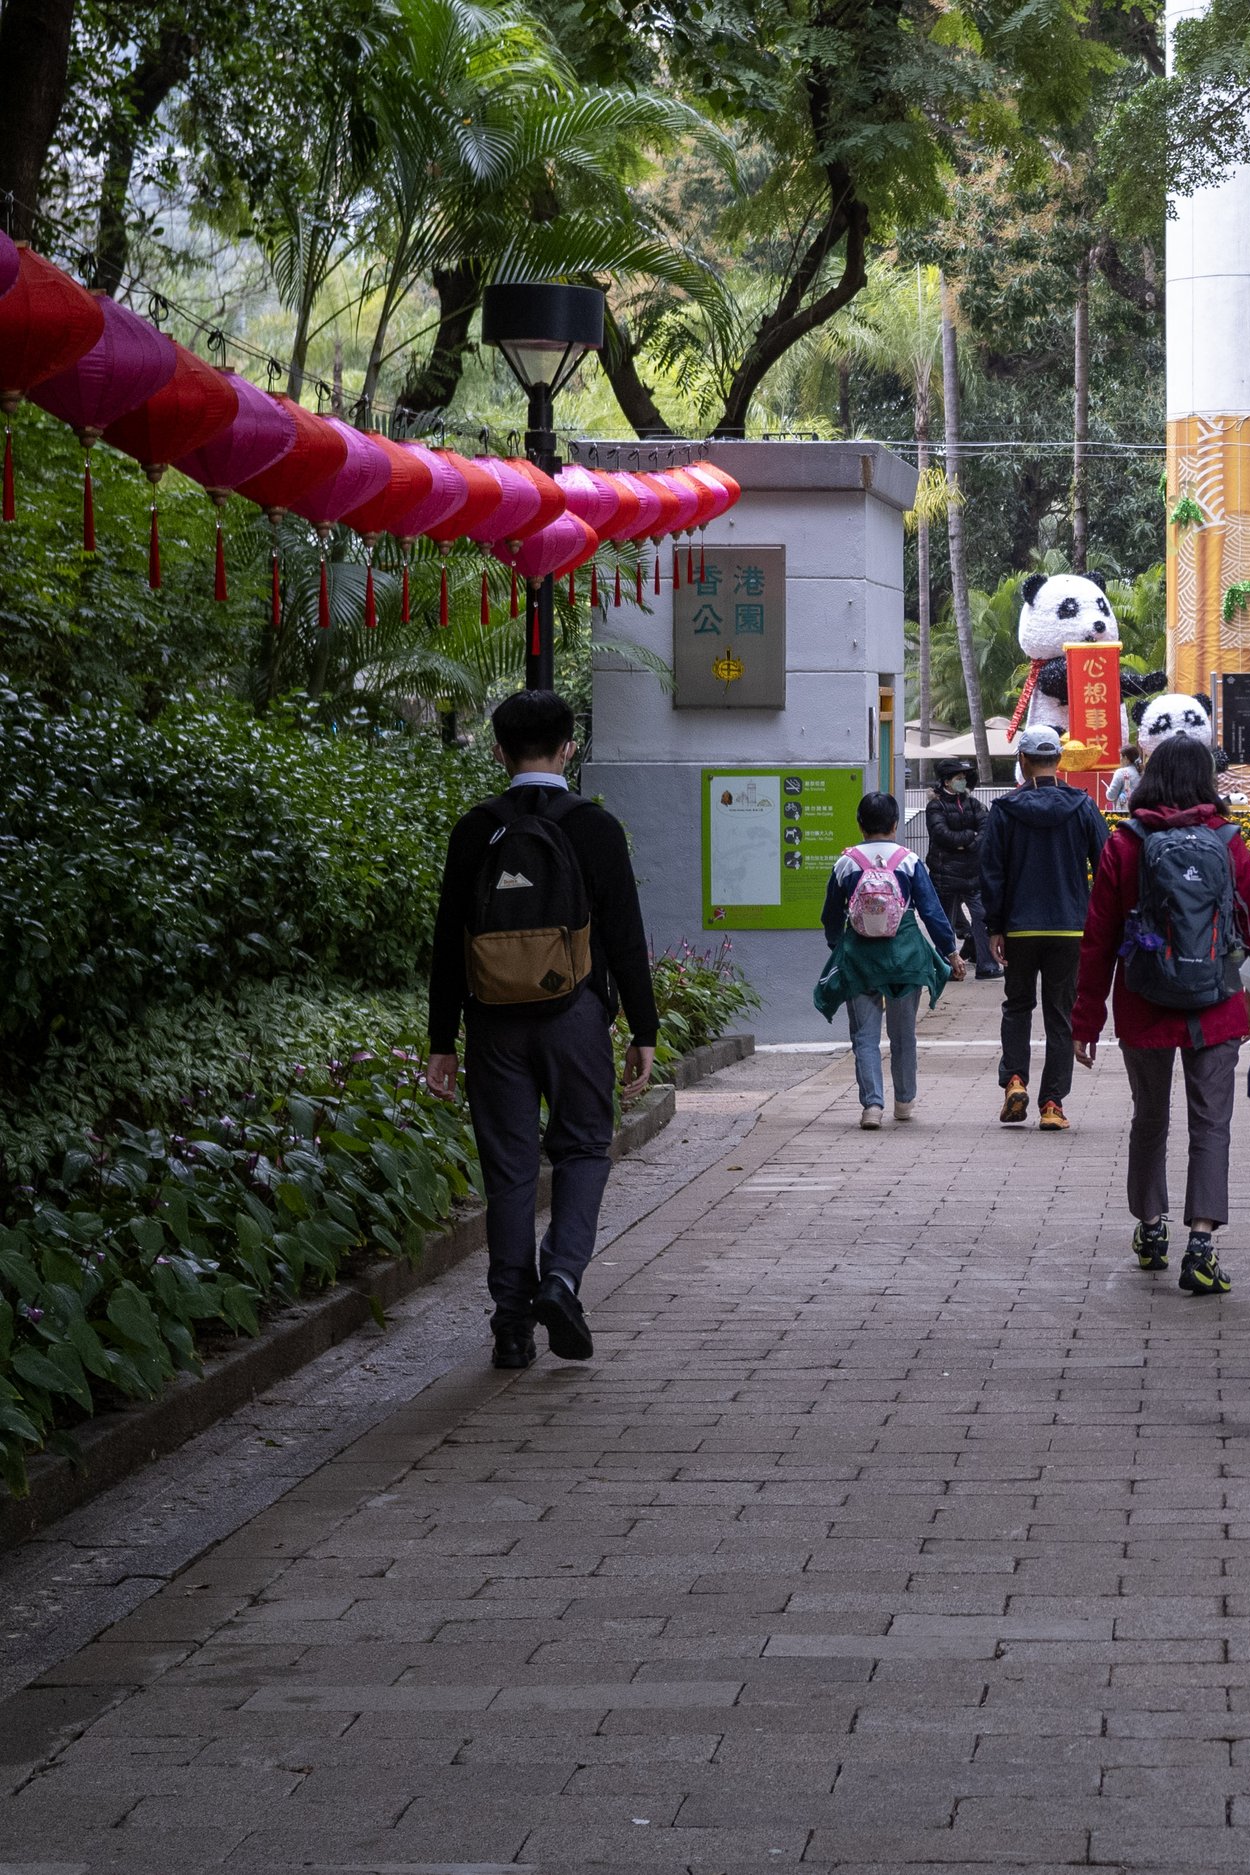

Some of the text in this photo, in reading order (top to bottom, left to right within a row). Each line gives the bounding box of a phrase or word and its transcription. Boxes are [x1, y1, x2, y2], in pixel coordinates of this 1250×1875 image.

[691, 564, 766, 597] 香港
[691, 602, 766, 636] 公園
[1082, 655, 1111, 757] 心想事成
